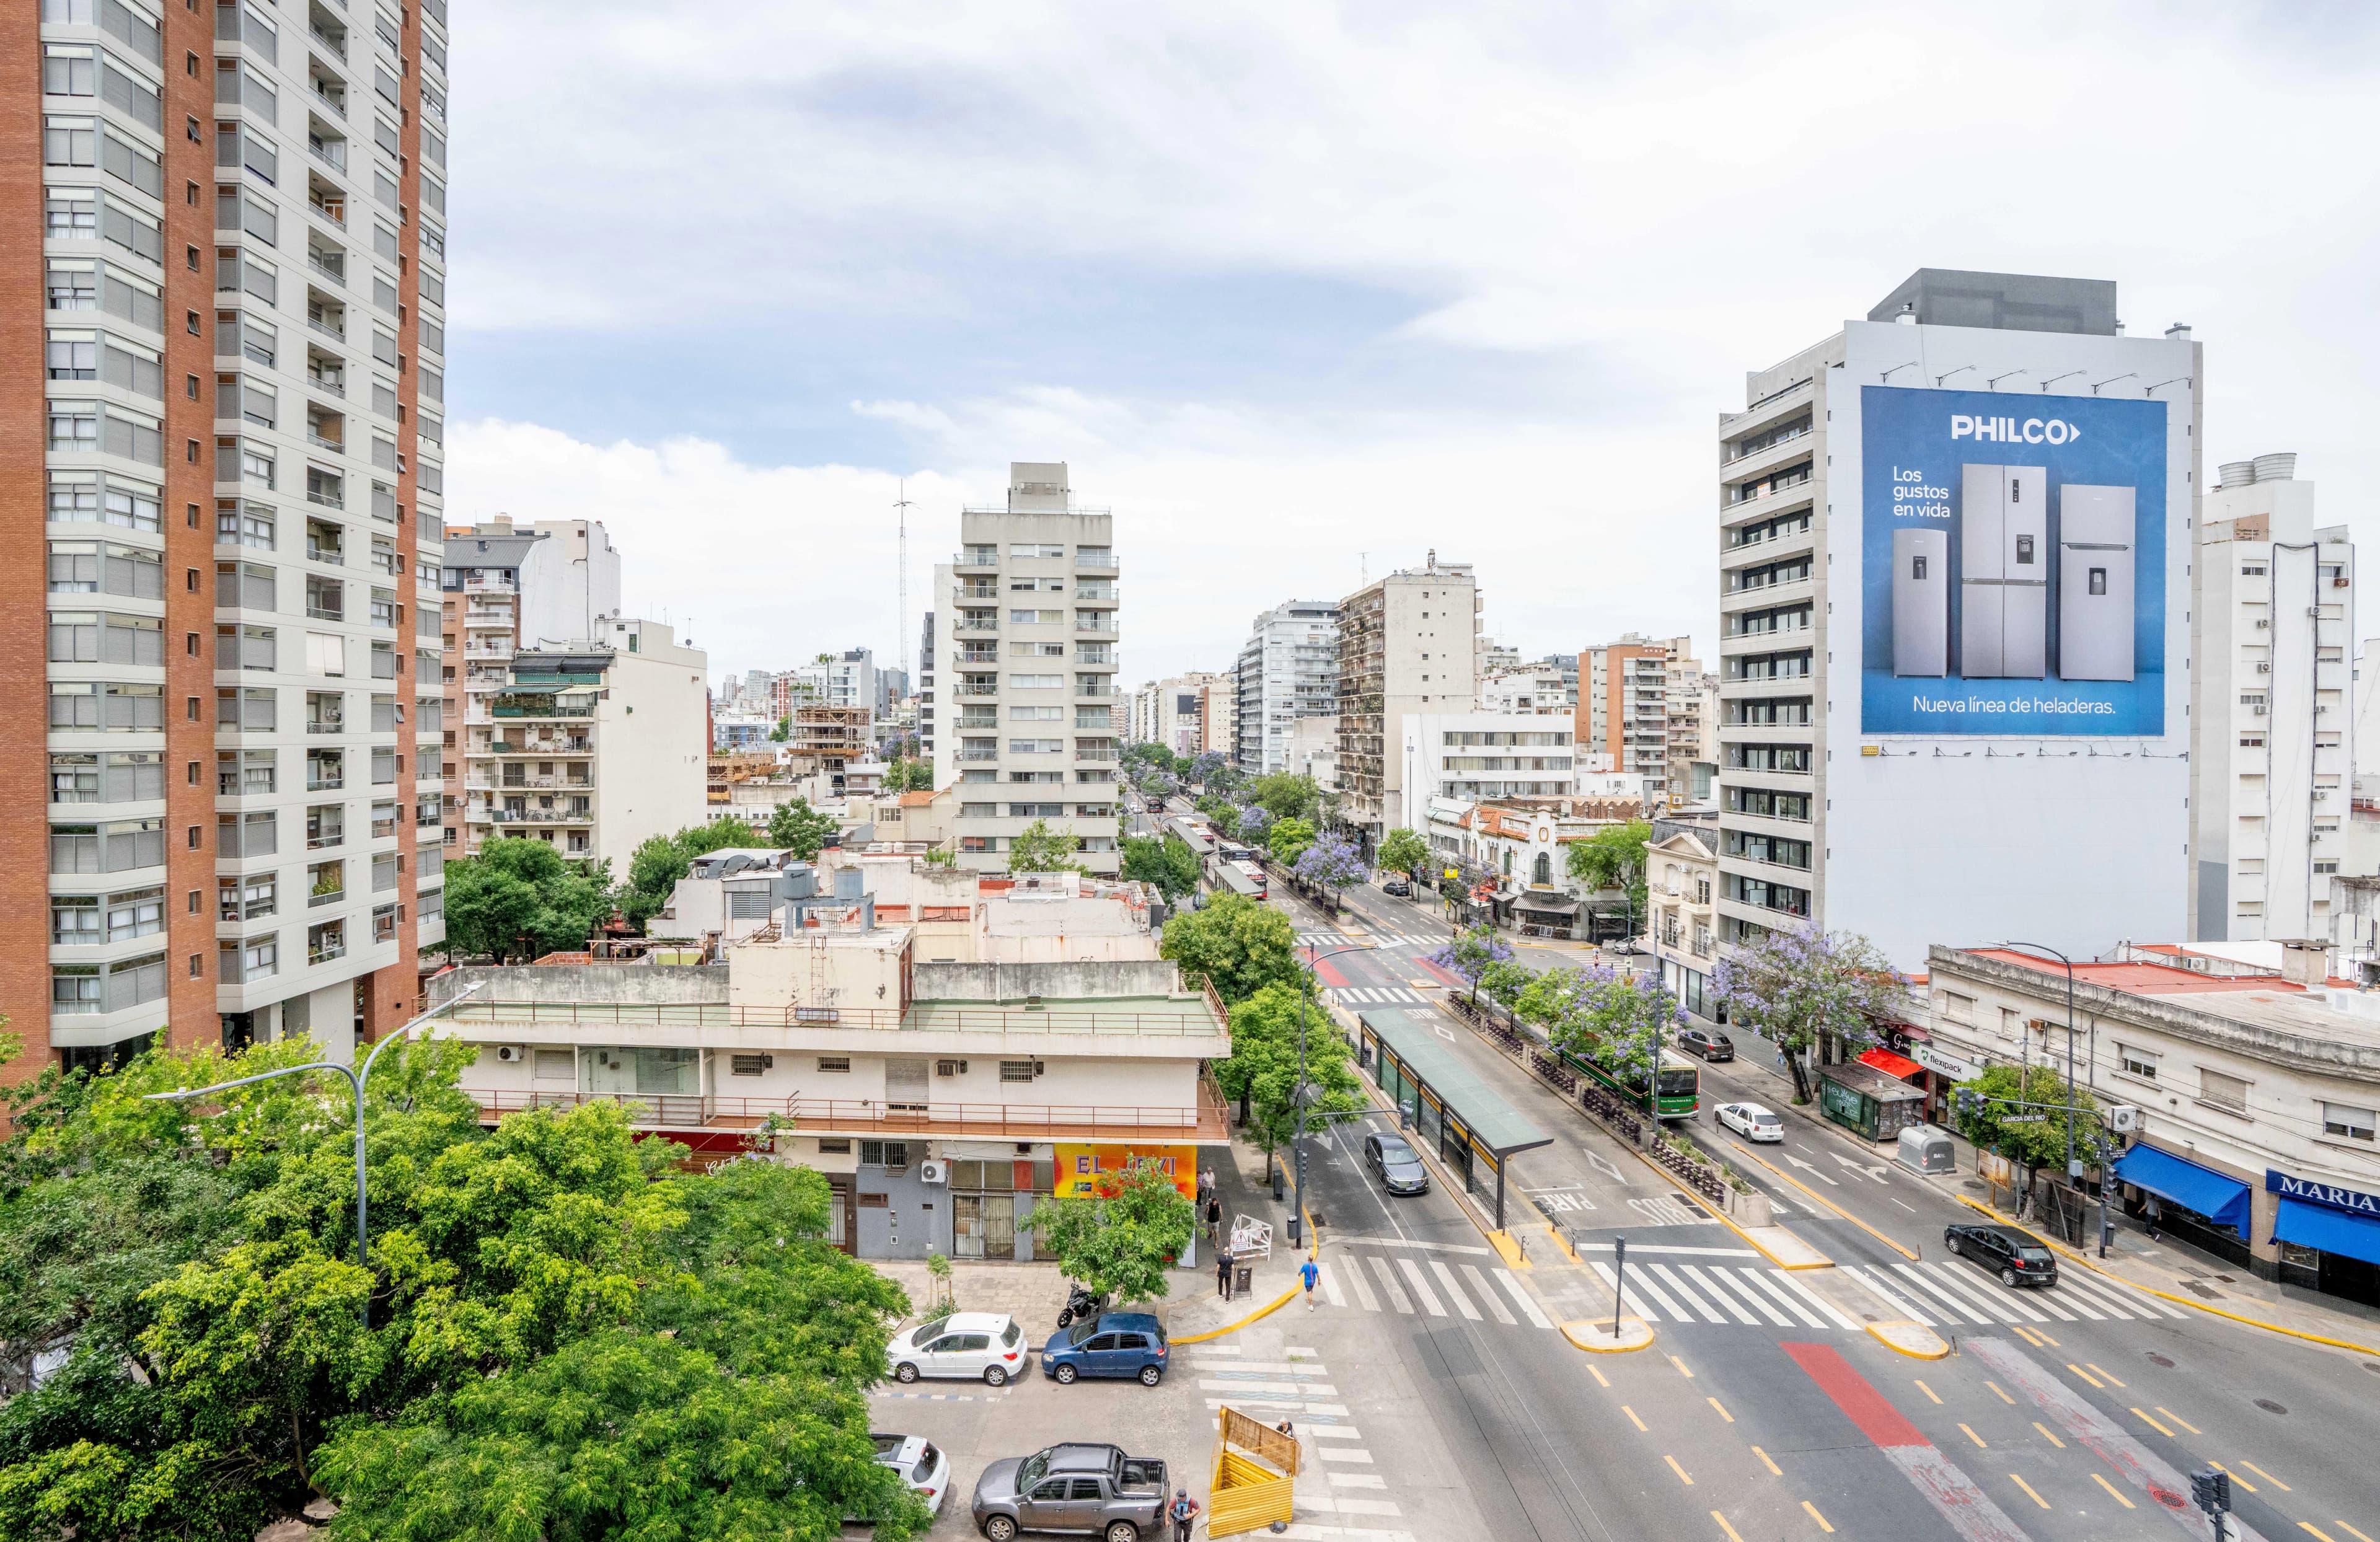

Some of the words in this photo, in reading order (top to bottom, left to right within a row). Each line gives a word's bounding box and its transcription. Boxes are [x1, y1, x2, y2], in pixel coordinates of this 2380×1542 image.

[1951, 415, 2069, 444] PHILCO
[1893, 465, 1923, 482] Los
[1893, 483, 1949, 501] gustos
[1893, 505, 1914, 517] en
[1918, 503, 1950, 518] vida
[1913, 695, 1966, 713] Nueva
[1968, 695, 2006, 713] línea
[2009, 696, 2031, 713] de
[2034, 697, 2117, 715] heladeras.
[1930, 1054, 1962, 1075] flexipack
[1075, 1155, 1103, 1177] EL
[2280, 1176, 2380, 1214] MARIA
